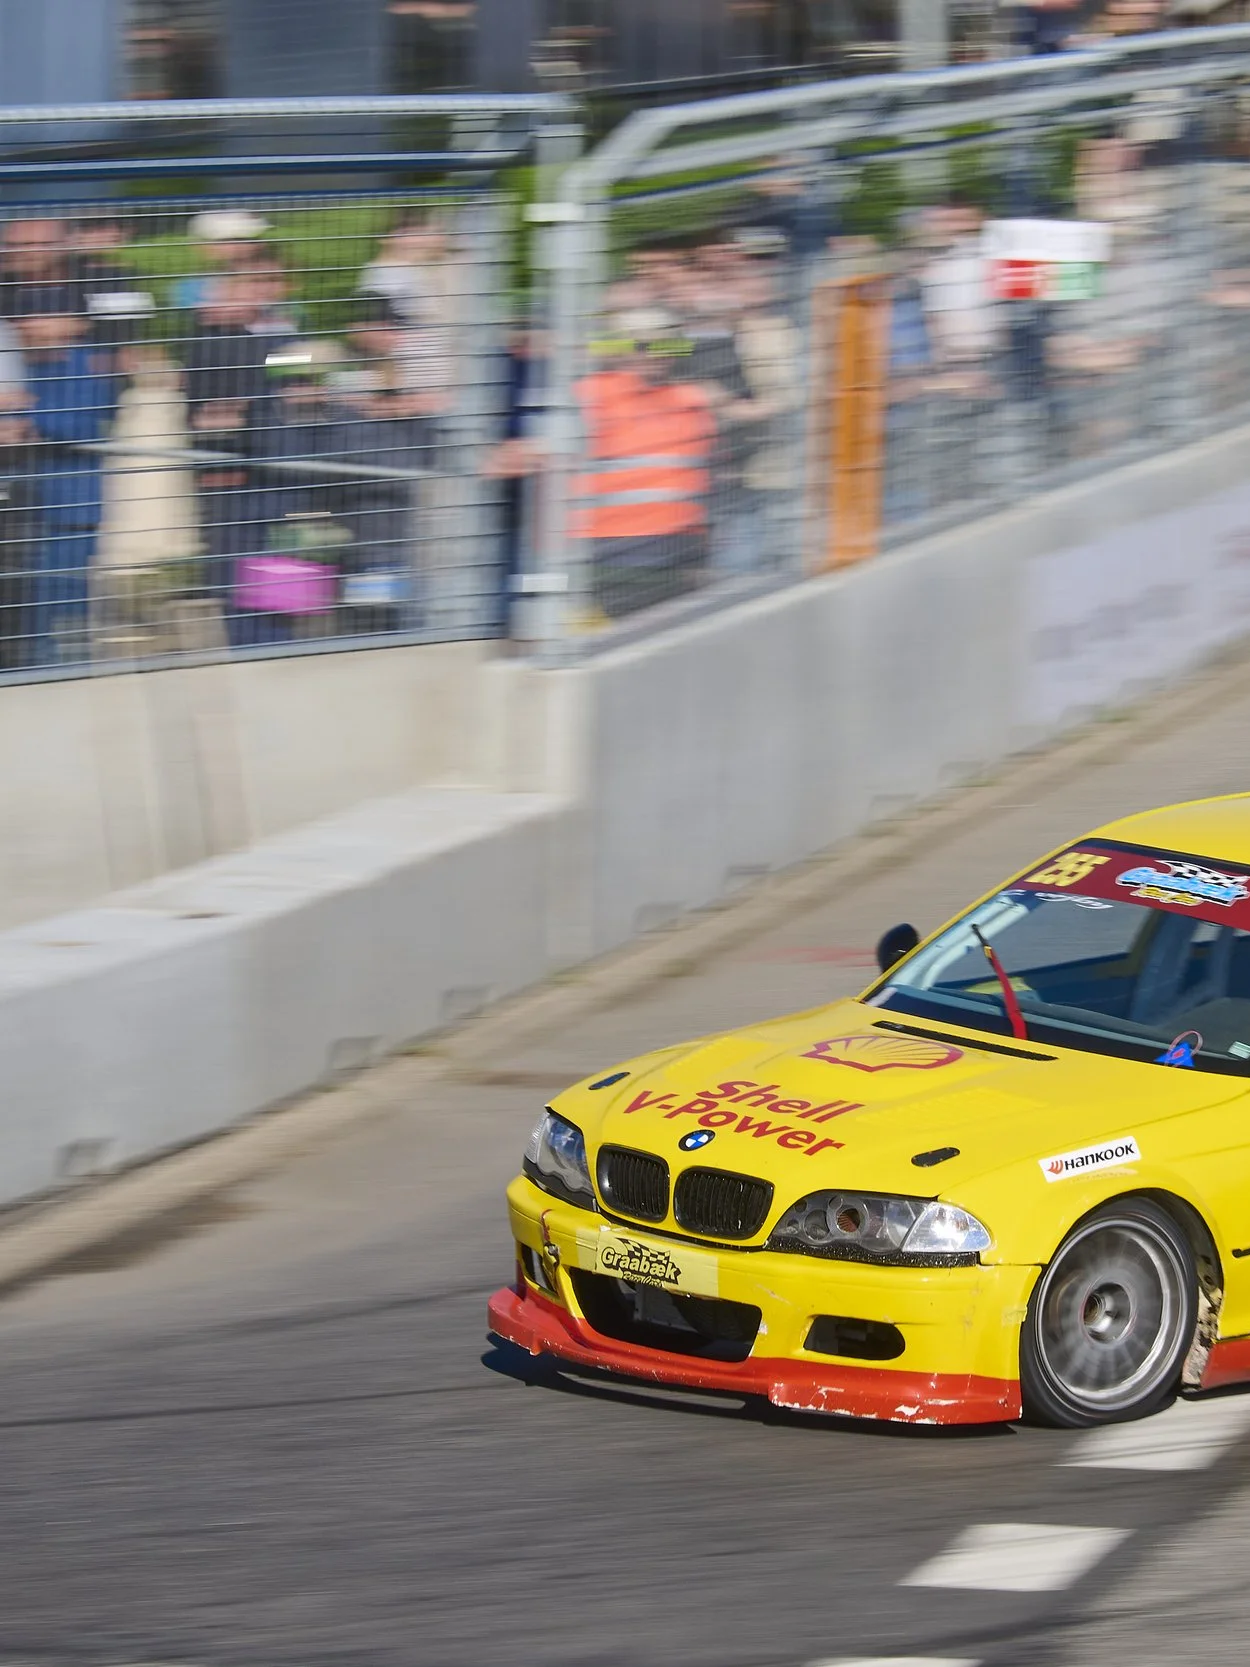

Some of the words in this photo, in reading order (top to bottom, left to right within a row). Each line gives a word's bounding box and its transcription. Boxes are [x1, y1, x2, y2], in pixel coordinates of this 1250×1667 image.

[623, 1090, 846, 1156] V-Power
[695, 1080, 865, 1124] Shell
[601, 1246, 679, 1282] Graabæk
